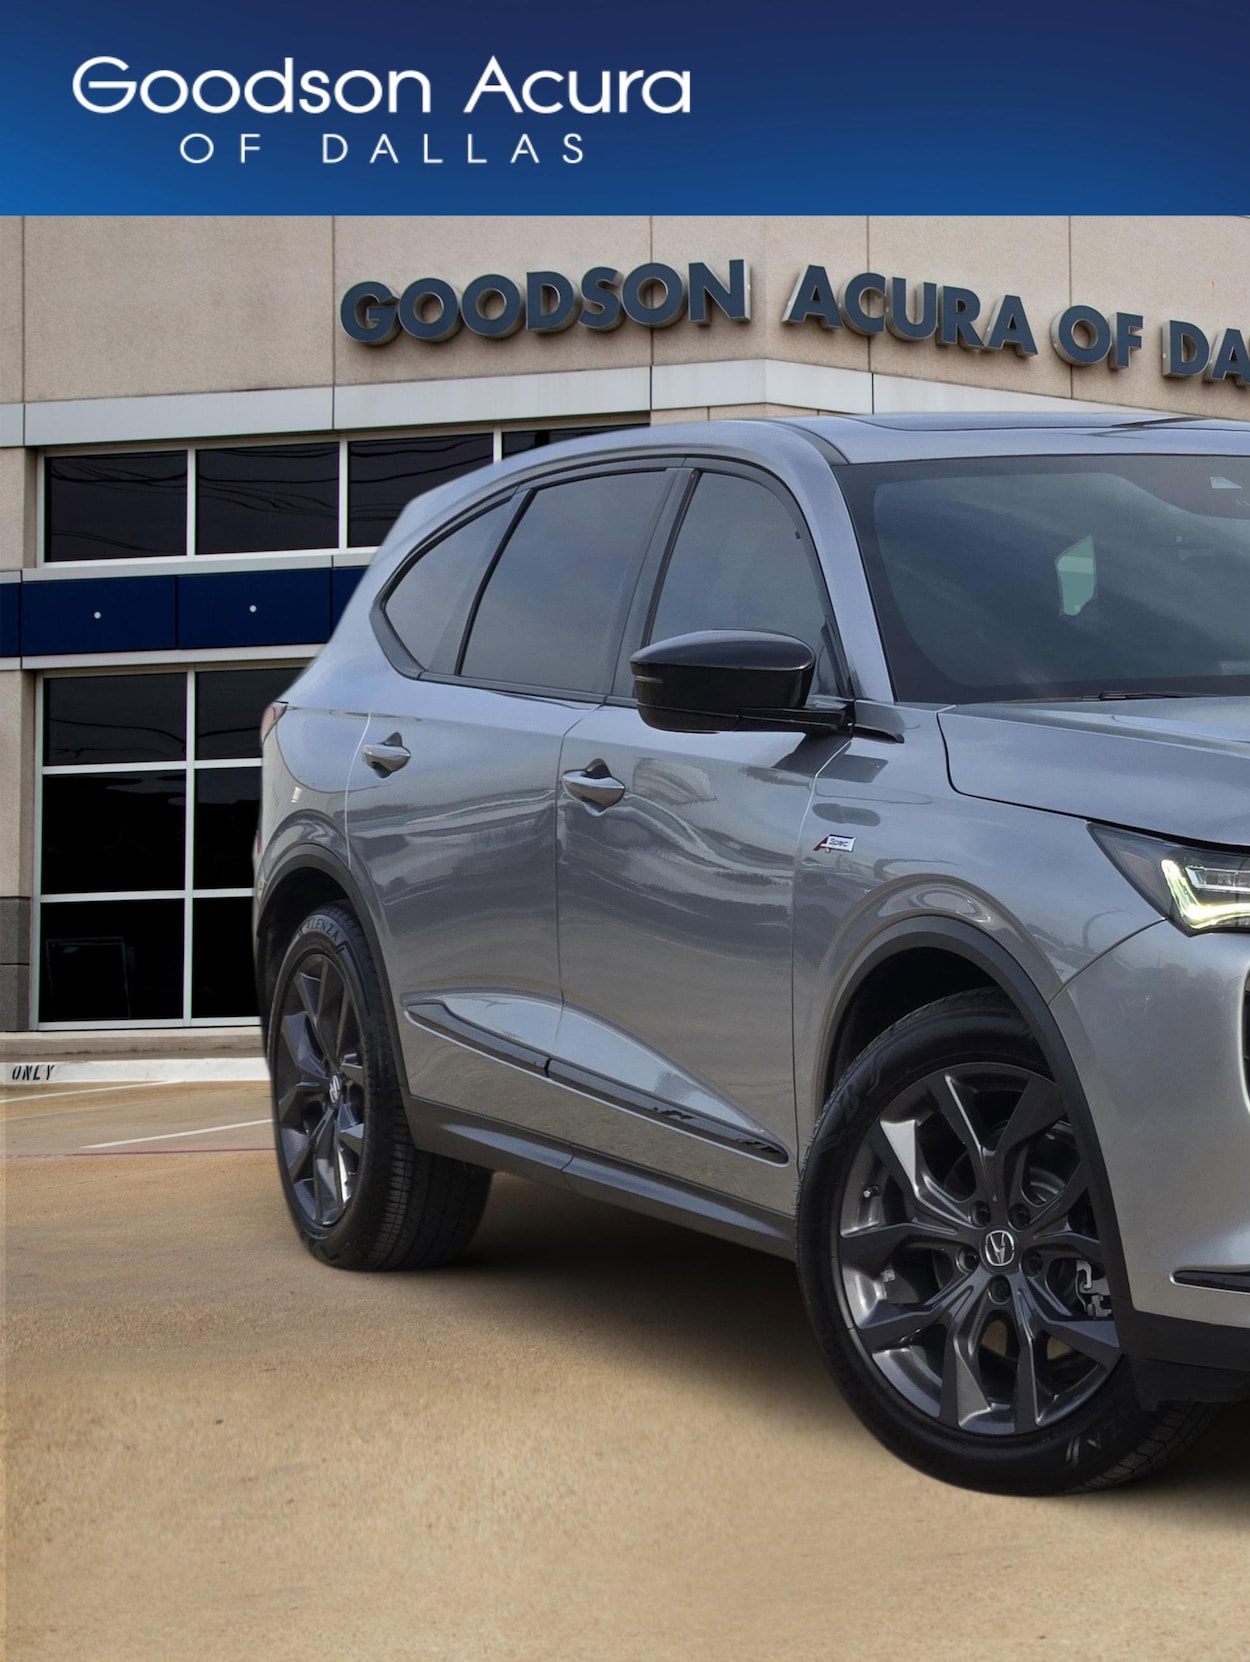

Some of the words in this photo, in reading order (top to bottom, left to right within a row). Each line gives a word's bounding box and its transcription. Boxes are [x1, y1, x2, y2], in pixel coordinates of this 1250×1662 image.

[340, 258, 752, 347] GOODSON
[783, 264, 1038, 358] ACURA
[1052, 304, 1145, 370] OF
[12, 1064, 56, 1081] ONLY
